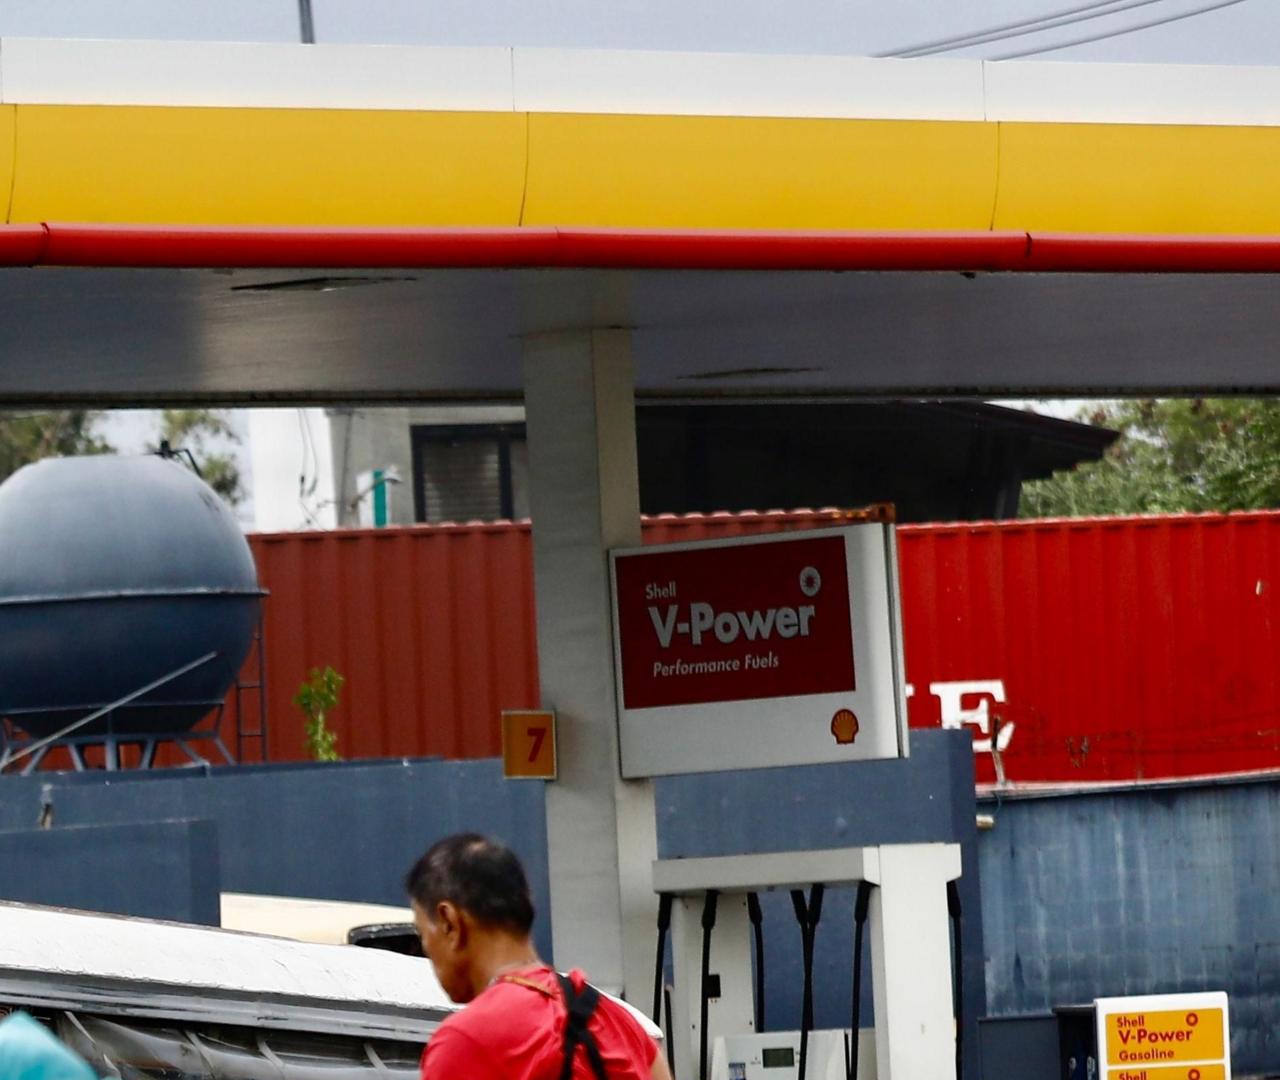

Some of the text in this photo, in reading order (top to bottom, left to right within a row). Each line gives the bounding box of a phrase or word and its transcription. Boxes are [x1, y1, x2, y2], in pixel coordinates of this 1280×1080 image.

[645, 581, 677, 601] Shell
[648, 601, 817, 649] V-Power
[653, 651, 780, 678] Performance Fuels
[920, 679, 1016, 753] E
[527, 728, 546, 763] 7
[1116, 1016, 1145, 1028] Shell
[1118, 1028, 1193, 1045] V-Power
[1119, 1049, 1175, 1062] Gasoline
